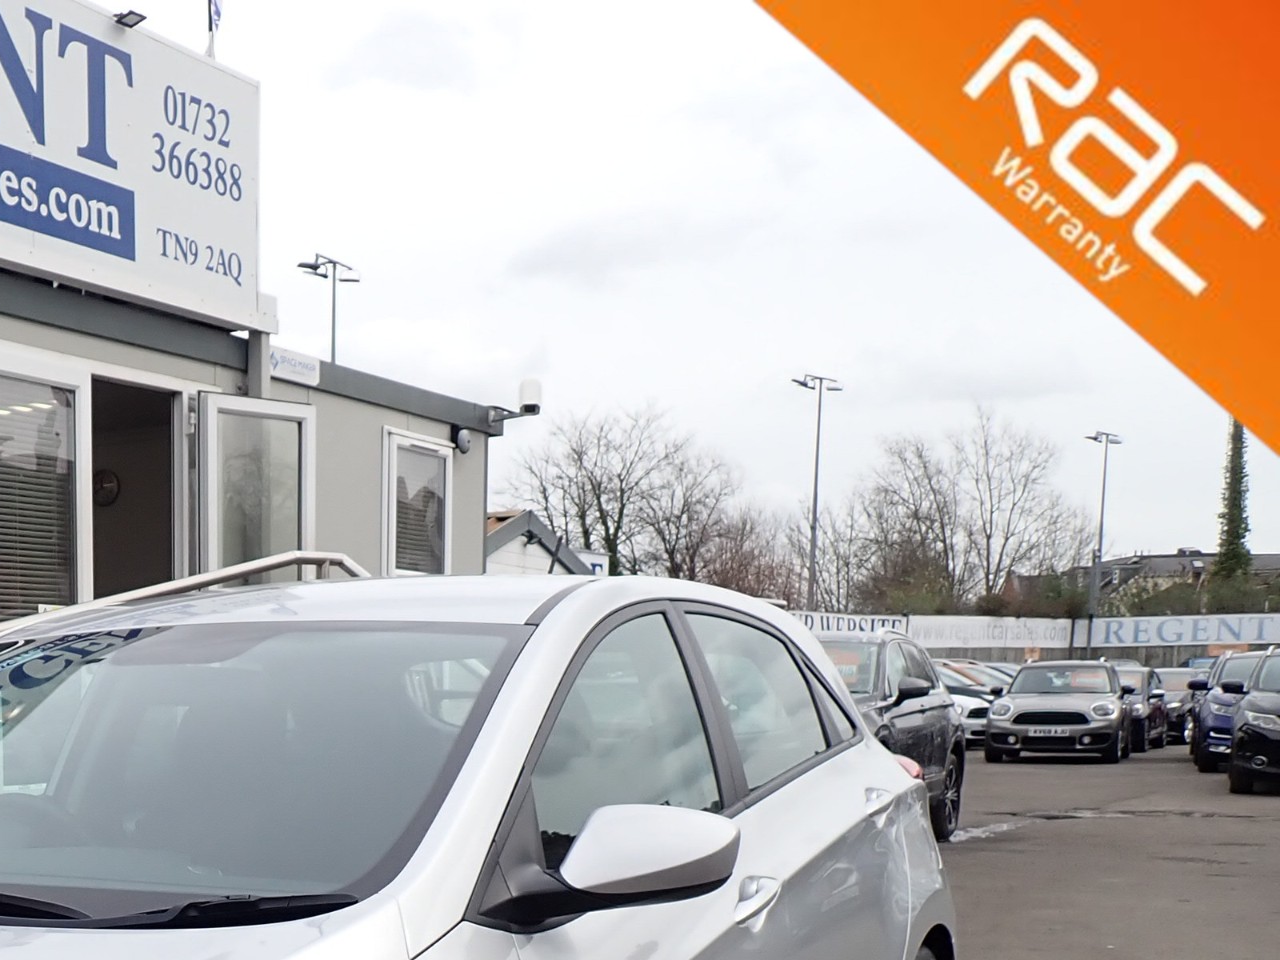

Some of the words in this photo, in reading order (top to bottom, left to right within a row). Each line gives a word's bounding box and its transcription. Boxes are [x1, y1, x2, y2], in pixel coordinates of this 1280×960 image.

[163, 85, 231, 148] 01732
[151, 132, 242, 202] 366388
[156, 227, 198, 266] TN9
[205, 245, 242, 287] 2AQ
[1102, 617, 1274, 644] REGENT
